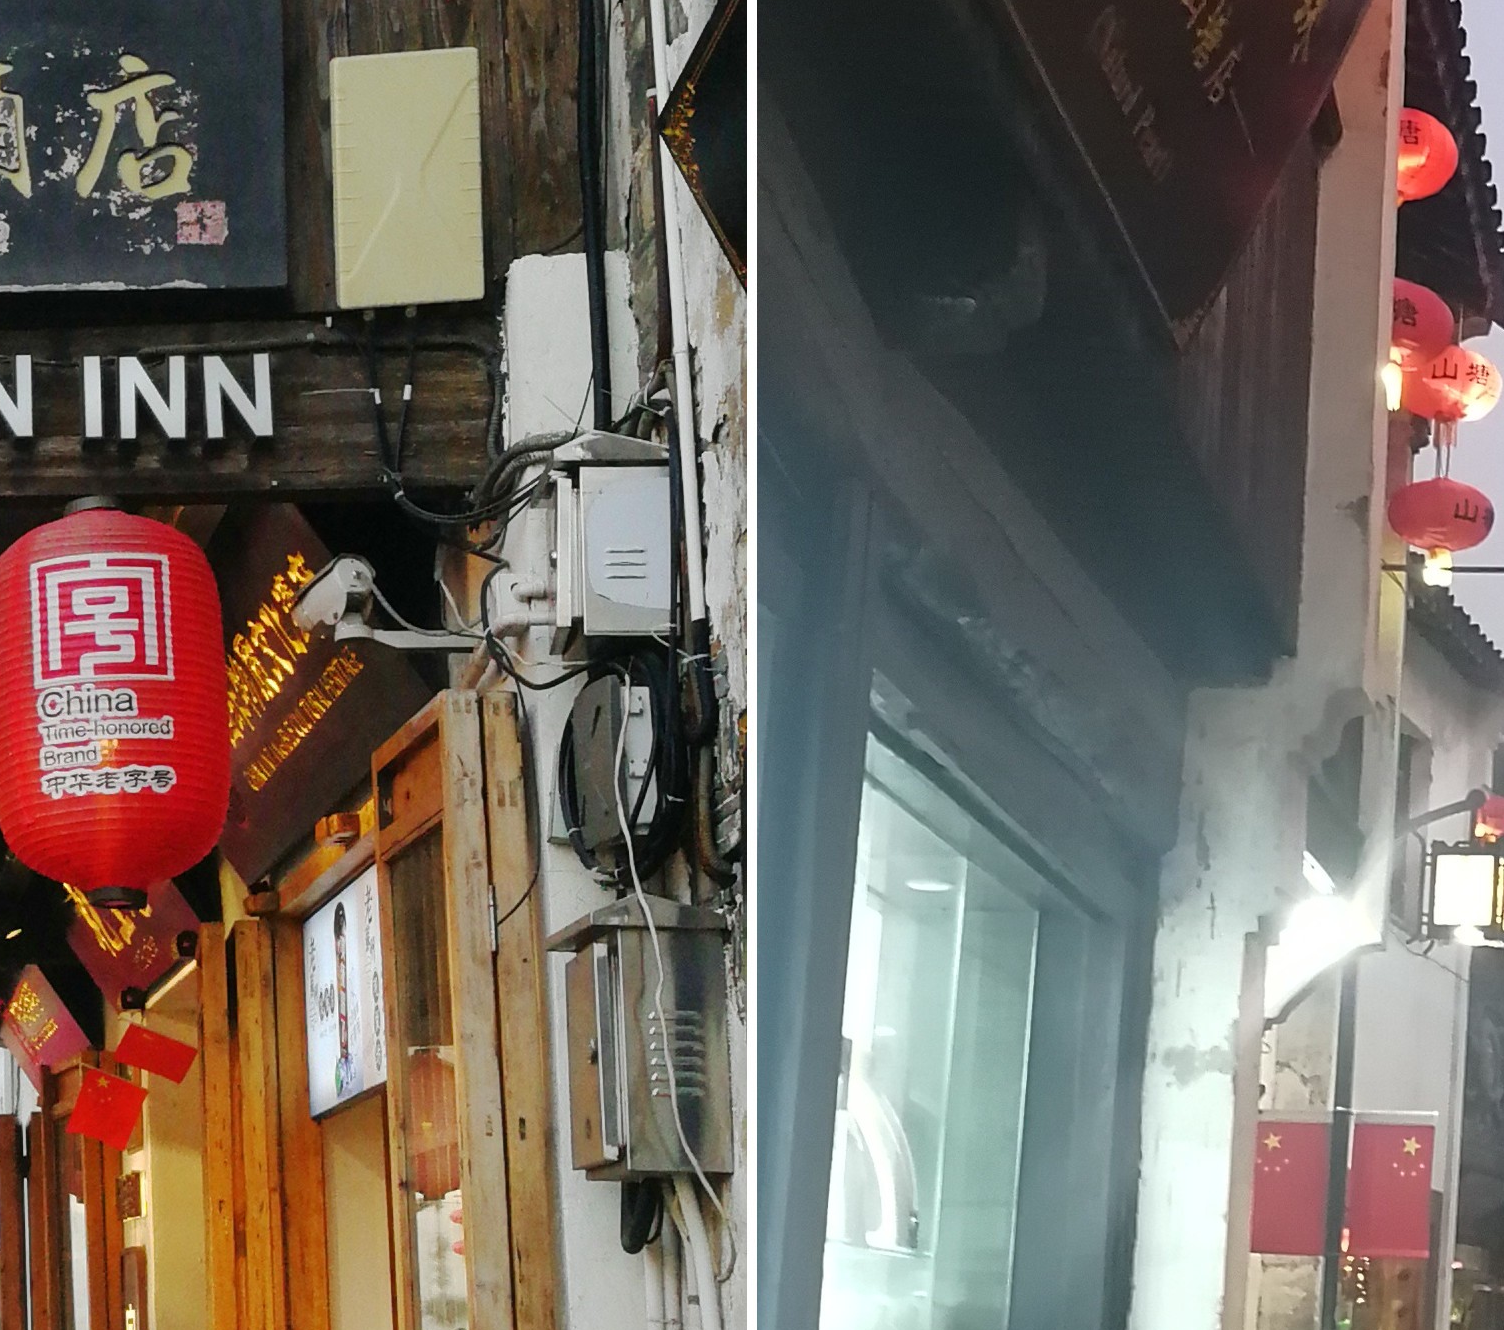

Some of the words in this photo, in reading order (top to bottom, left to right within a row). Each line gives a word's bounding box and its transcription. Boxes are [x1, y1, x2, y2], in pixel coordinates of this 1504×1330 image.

[1431, 357, 1491, 386] 山塘
[82, 353, 274, 441] INN
[41, 688, 135, 718] China
[43, 719, 171, 741] Time-honored
[44, 746, 98, 767] Brand
[47, 769, 174, 793] 中华老字号
